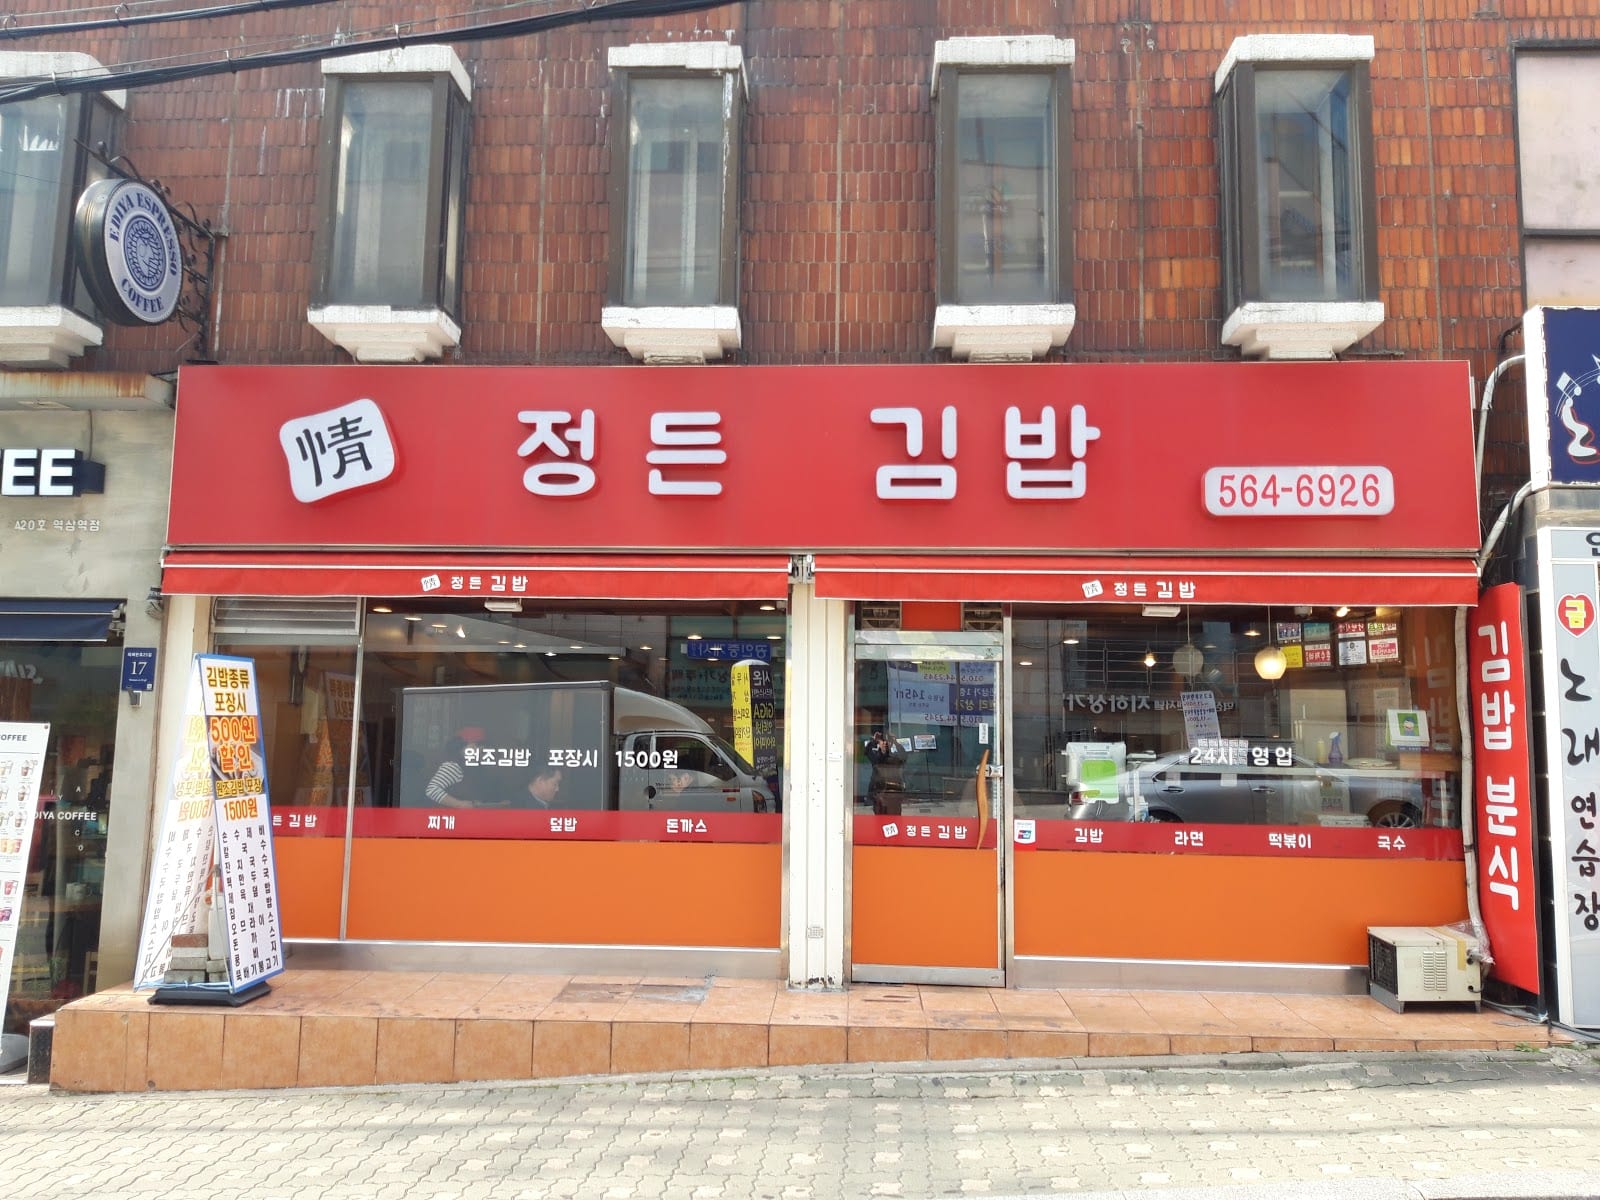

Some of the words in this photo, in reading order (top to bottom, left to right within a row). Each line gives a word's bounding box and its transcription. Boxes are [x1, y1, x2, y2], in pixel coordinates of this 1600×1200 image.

[109, 193, 135, 244] EDIYA
[136, 192, 178, 276] ESPRESSO
[121, 278, 164, 313] COFFEE
[296, 416, 373, 487] 情
[517, 408, 727, 497] 정든
[870, 404, 1101, 499] 김밥
[1218, 473, 1381, 508] 564-6926
[53, 519, 100, 532] 역삼역점
[130, 661, 148, 676] 17
[206, 666, 250, 689] 김밥종류
[1478, 620, 1516, 750] 김밥
[214, 692, 247, 713] 포장시
[0, 734, 28, 742] OFFEE
[211, 716, 257, 743] 500원
[219, 744, 254, 771] 할인
[463, 747, 532, 768] 원조김밥
[547, 747, 599, 768] 포장시
[615, 747, 679, 769] 1500원
[1190, 747, 1234, 766] 24시
[246, 778, 263, 795] 포장
[57, 812, 97, 821] COFFEE
[223, 797, 258, 822] 1500원
[289, 814, 318, 828] 김밥
[427, 814, 456, 831] 찌개
[549, 816, 578, 833] 덮밥
[665, 817, 707, 834] 돈까스
[938, 824, 968, 839] 김밥
[1074, 827, 1104, 843] 김밥
[1174, 830, 1204, 846] 라면
[1268, 832, 1312, 849] 떡볶이
[1377, 834, 1406, 850] 국수
[1485, 775, 1520, 911] 분식
